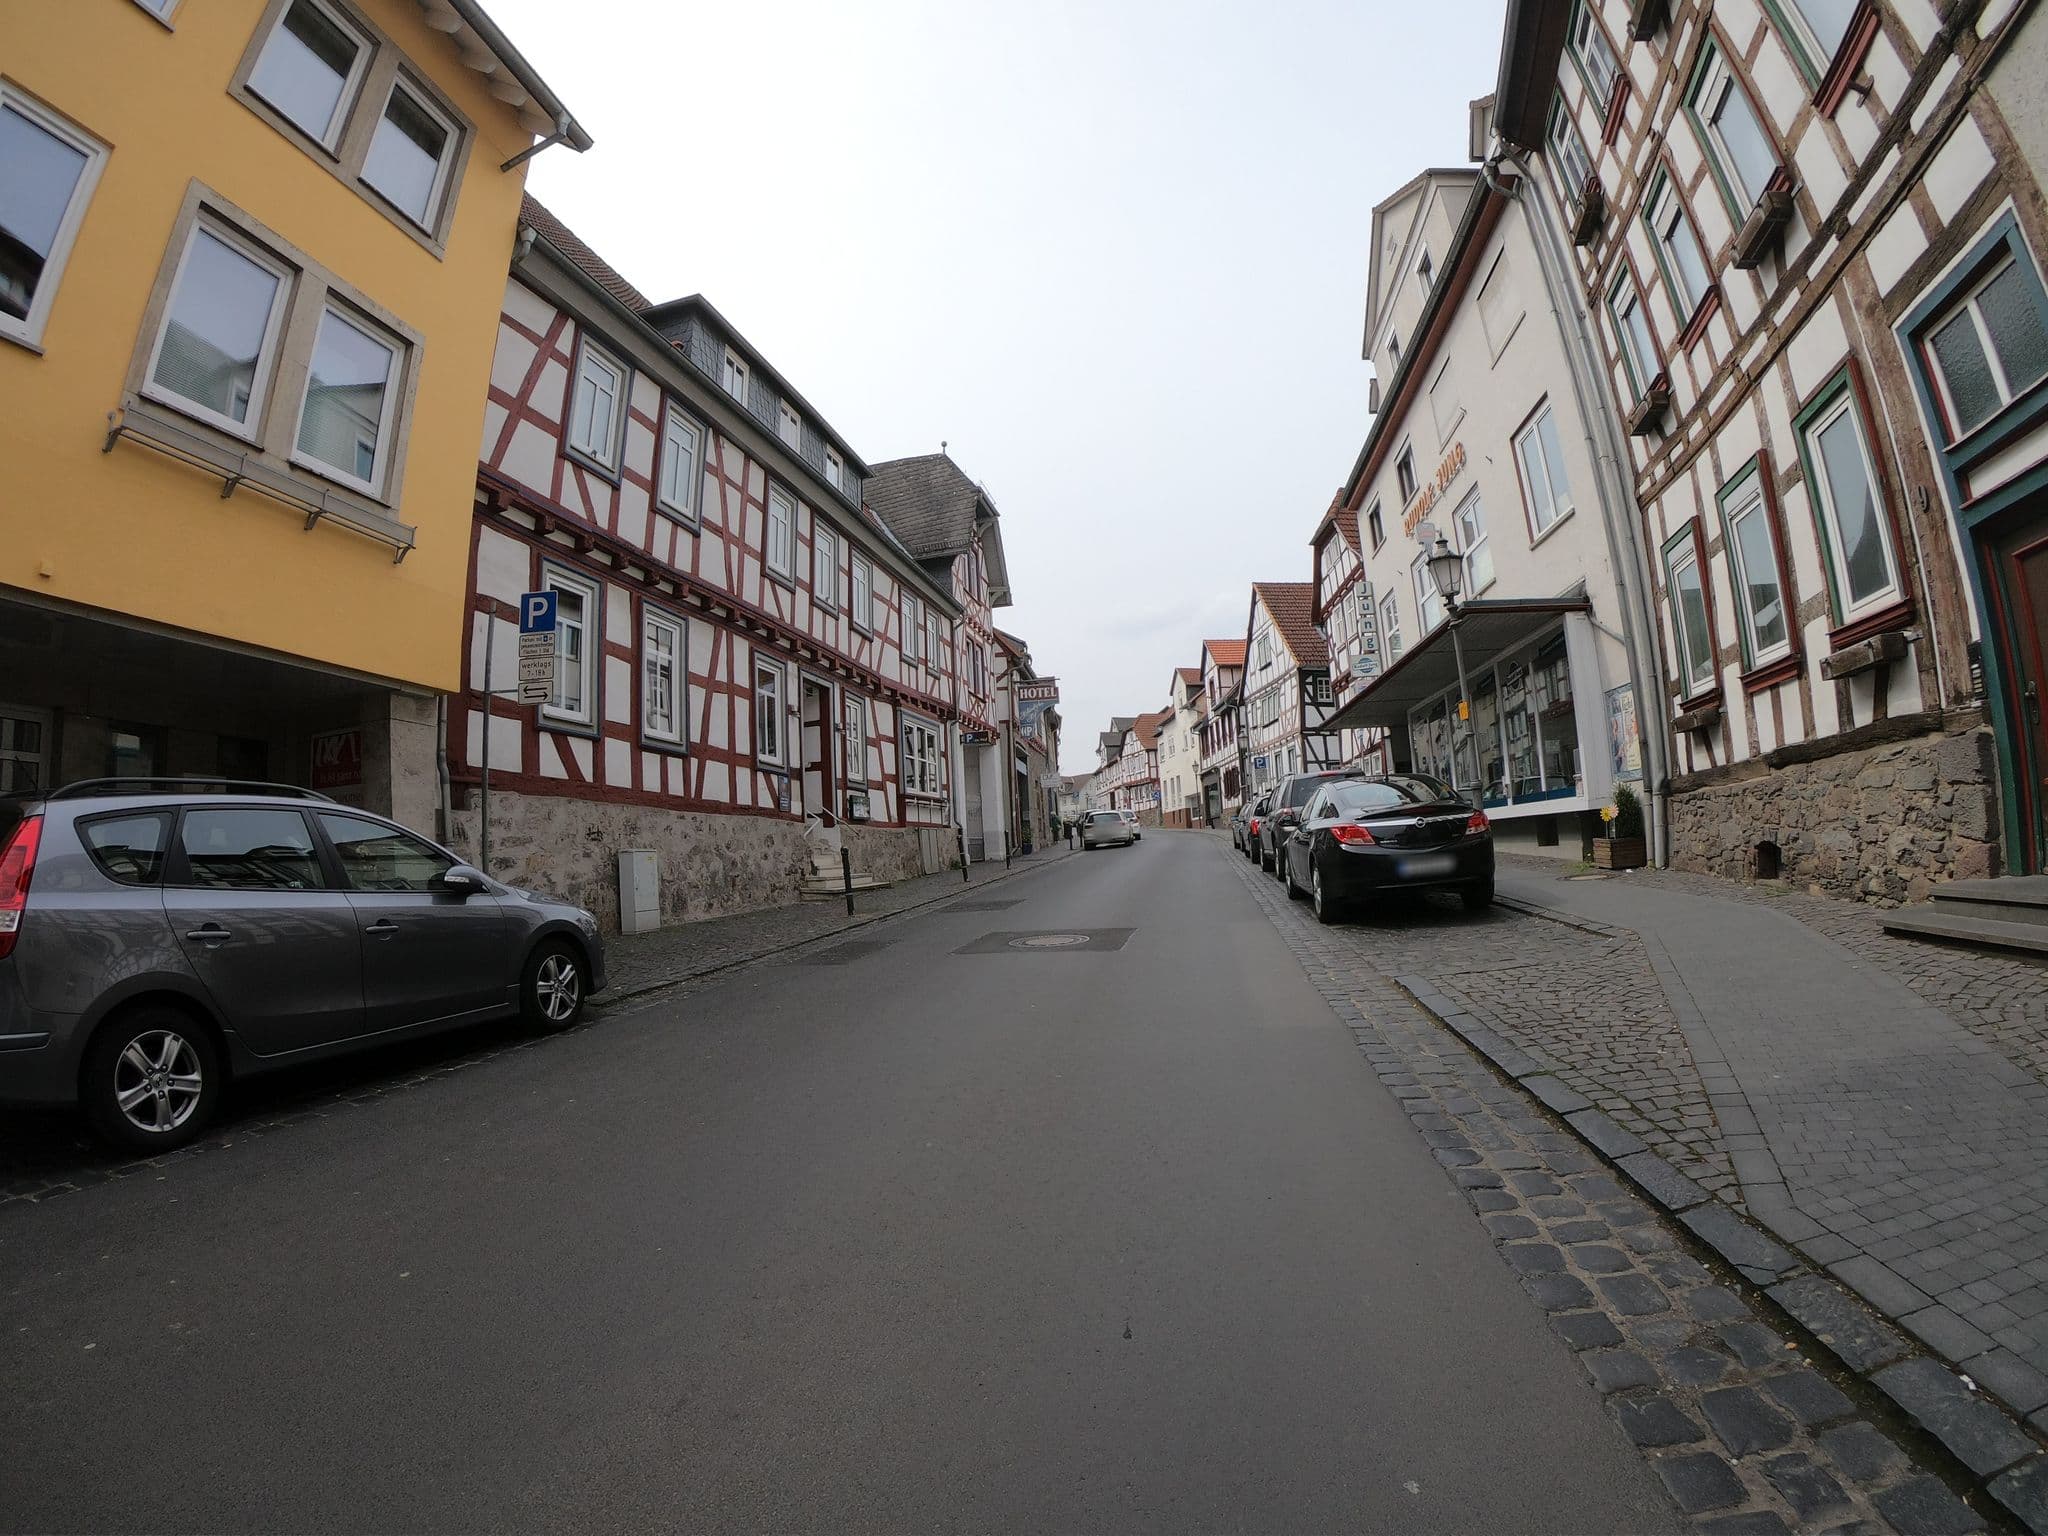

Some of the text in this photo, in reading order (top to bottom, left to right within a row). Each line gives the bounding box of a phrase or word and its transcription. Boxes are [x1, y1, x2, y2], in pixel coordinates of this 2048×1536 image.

[1918, 485, 1930, 513] 9
[528, 597, 548, 628] P
[521, 660, 552, 670] werktags
[1019, 687, 1057, 699] HOTEL
[966, 734, 973, 743] P
